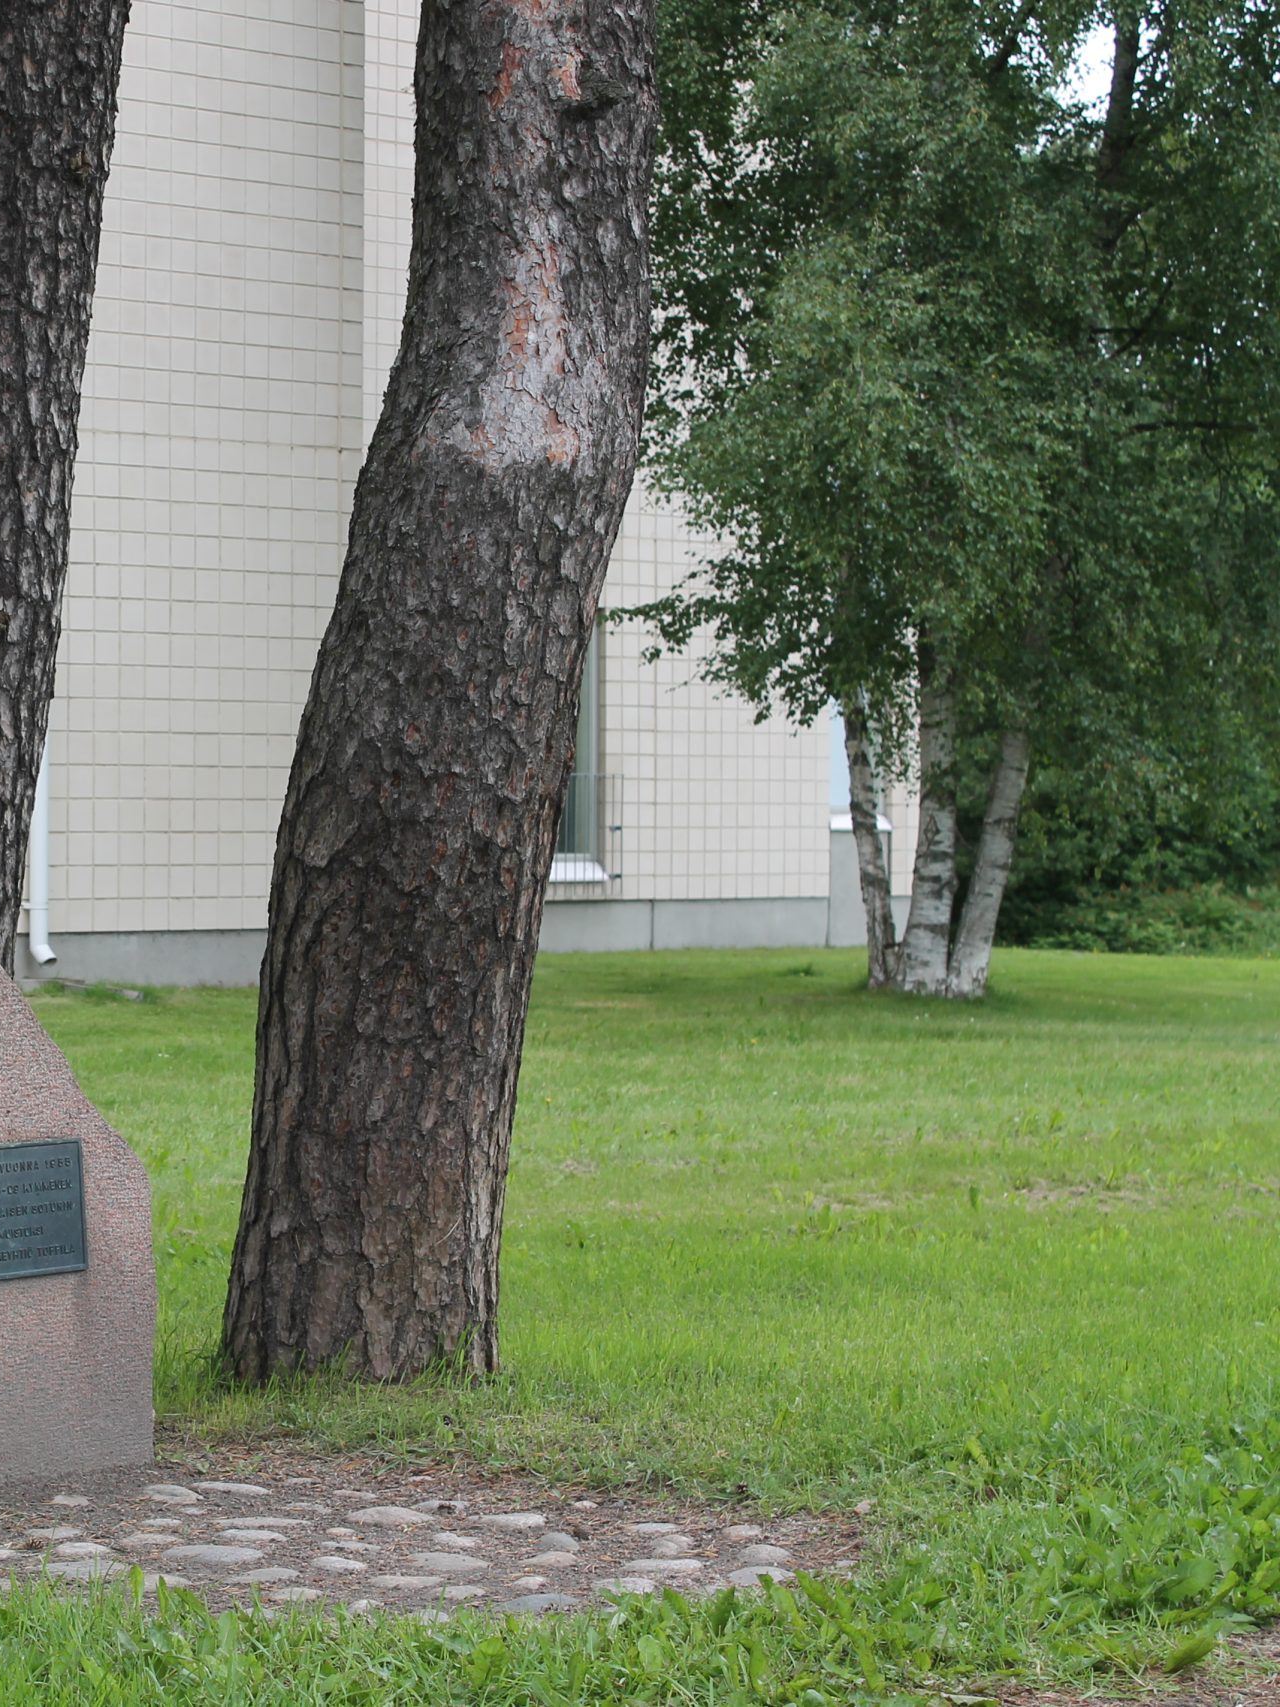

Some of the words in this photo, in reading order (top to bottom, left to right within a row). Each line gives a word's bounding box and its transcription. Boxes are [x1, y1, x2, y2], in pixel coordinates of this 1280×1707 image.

[0, 1160, 39, 1174] VUONNA
[23, 1179, 72, 1194] KYMMENEN
[31, 1201, 73, 1215] SOTURIN
[36, 1244, 76, 1258] TOPPILA
